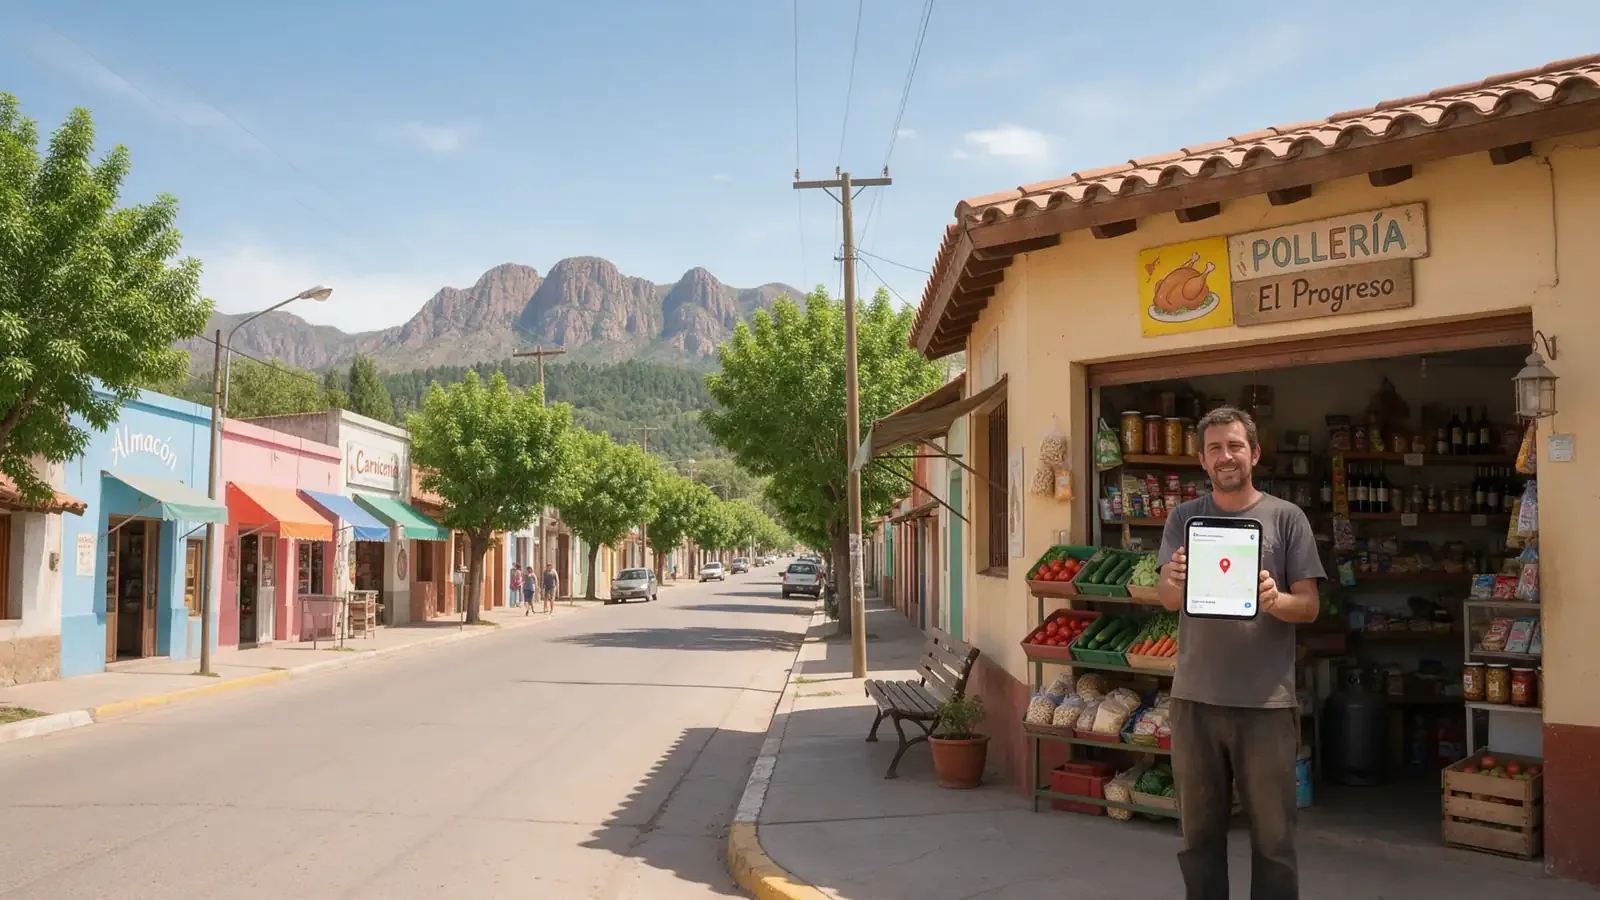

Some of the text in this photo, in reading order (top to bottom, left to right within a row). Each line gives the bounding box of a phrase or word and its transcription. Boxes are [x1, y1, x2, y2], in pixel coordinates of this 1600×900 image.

[1252, 211, 1407, 272] POLLERÍA
[1258, 278, 1395, 313] El Progreso
